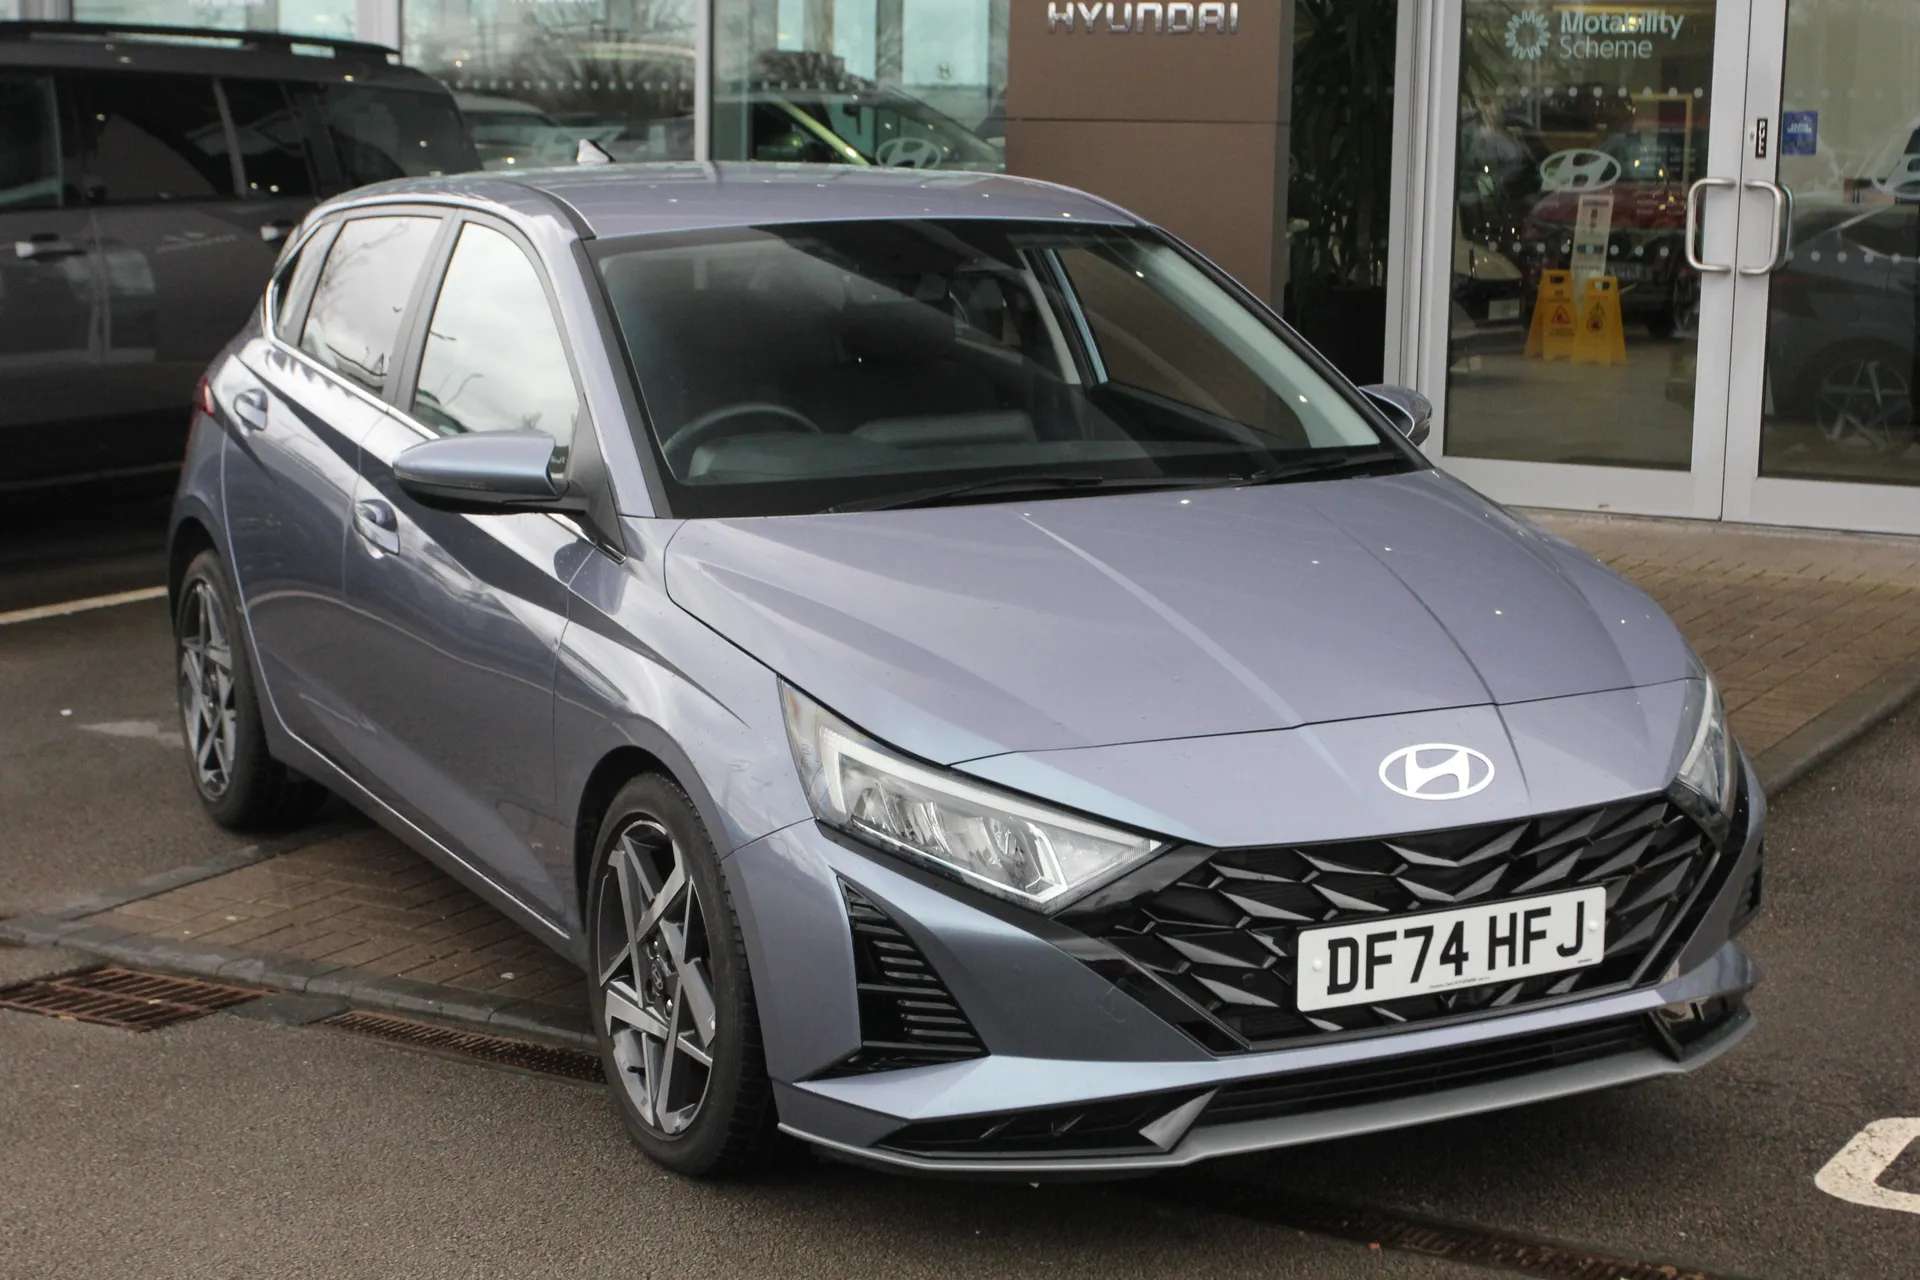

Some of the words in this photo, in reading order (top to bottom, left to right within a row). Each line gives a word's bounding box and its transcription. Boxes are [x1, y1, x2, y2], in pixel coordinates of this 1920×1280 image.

[1047, 2, 1239, 33] HYUNDAI
[1560, 10, 1684, 40] Motability
[1559, 35, 1653, 60] Scheme
[1327, 920, 1469, 995] DF74
[1488, 901, 1584, 971] HFJ
